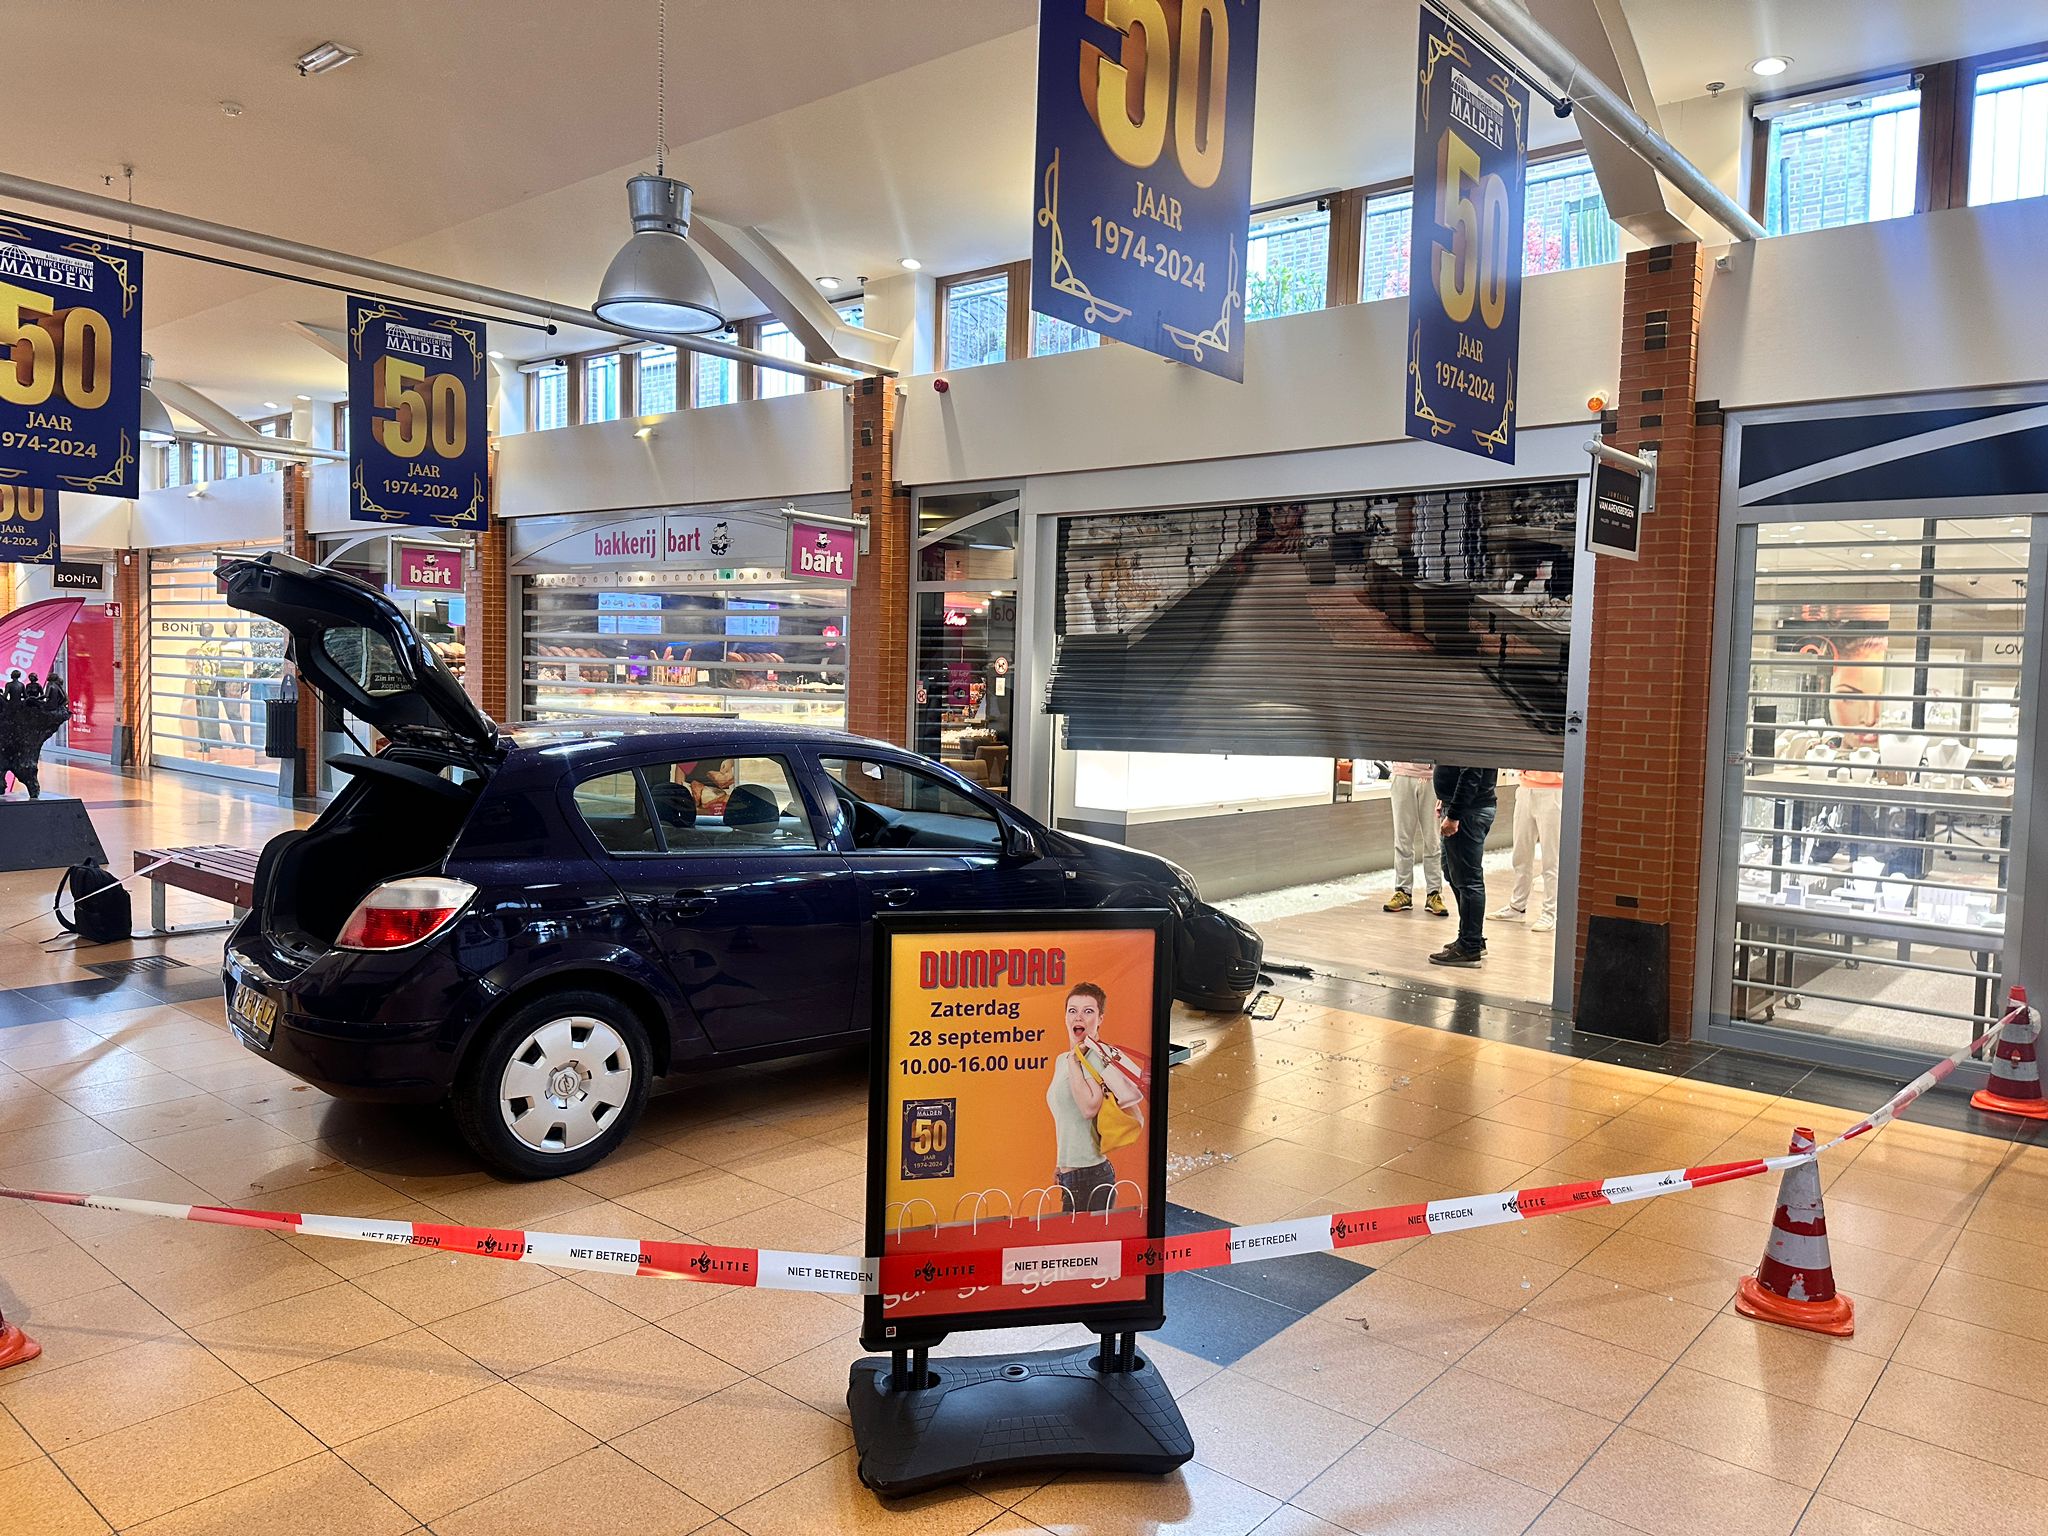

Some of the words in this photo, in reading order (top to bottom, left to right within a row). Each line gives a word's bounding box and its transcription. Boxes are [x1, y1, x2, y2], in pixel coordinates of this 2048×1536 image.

[1079, 0, 1229, 189] 50
[1451, 93, 1503, 147] MALDEN
[1133, 181, 1182, 231] JAAR
[1431, 128, 1509, 329] 50
[1091, 215, 1206, 292] 1974-2024
[0, 258, 93, 289] MALDEN
[35, 257, 93, 276] WINKELCENTRUM
[0, 282, 111, 409] 50
[386, 336, 452, 358] MALDEN
[1457, 333, 1483, 362] JAAR
[1435, 361, 1495, 403] 1974-2024
[372, 354, 467, 458] 50
[26, 411, 72, 432] JAAR
[2, 431, 98, 458] 974-2024
[407, 463, 440, 477] JAAR
[383, 480, 458, 499] 1974-2024
[1, 524, 25, 533] JAAR
[595, 530, 656, 558] bakkerij
[667, 527, 700, 553] bart
[800, 547, 843, 574] bart
[410, 565, 451, 584] bart
[0, 628, 45, 683] bart
[920, 948, 1066, 989] DUMPDAG
[931, 1000, 1020, 1019] Zaterdag
[909, 1030, 932, 1047] 28
[938, 1027, 1045, 1049] september
[900, 1055, 1009, 1075] 10.00-16.00
[1014, 1056, 1048, 1070] uur
[917, 1109, 942, 1117] MALDEN
[911, 1119, 947, 1155] 50
[1572, 1191, 1590, 1201] NIET
[1407, 1214, 1427, 1225] NIET
[1428, 1208, 1473, 1222] BETREDEN
[1225, 1240, 1247, 1251] NIET
[1248, 1233, 1297, 1248] BETREDEN
[570, 1248, 593, 1260] NIET
[595, 1250, 652, 1264] BETREDEN
[1014, 1261, 1038, 1271] NIET
[1041, 1257, 1098, 1269] BETREDEN
[787, 1266, 811, 1277] NIET
[814, 1268, 873, 1282] BETREDEN
